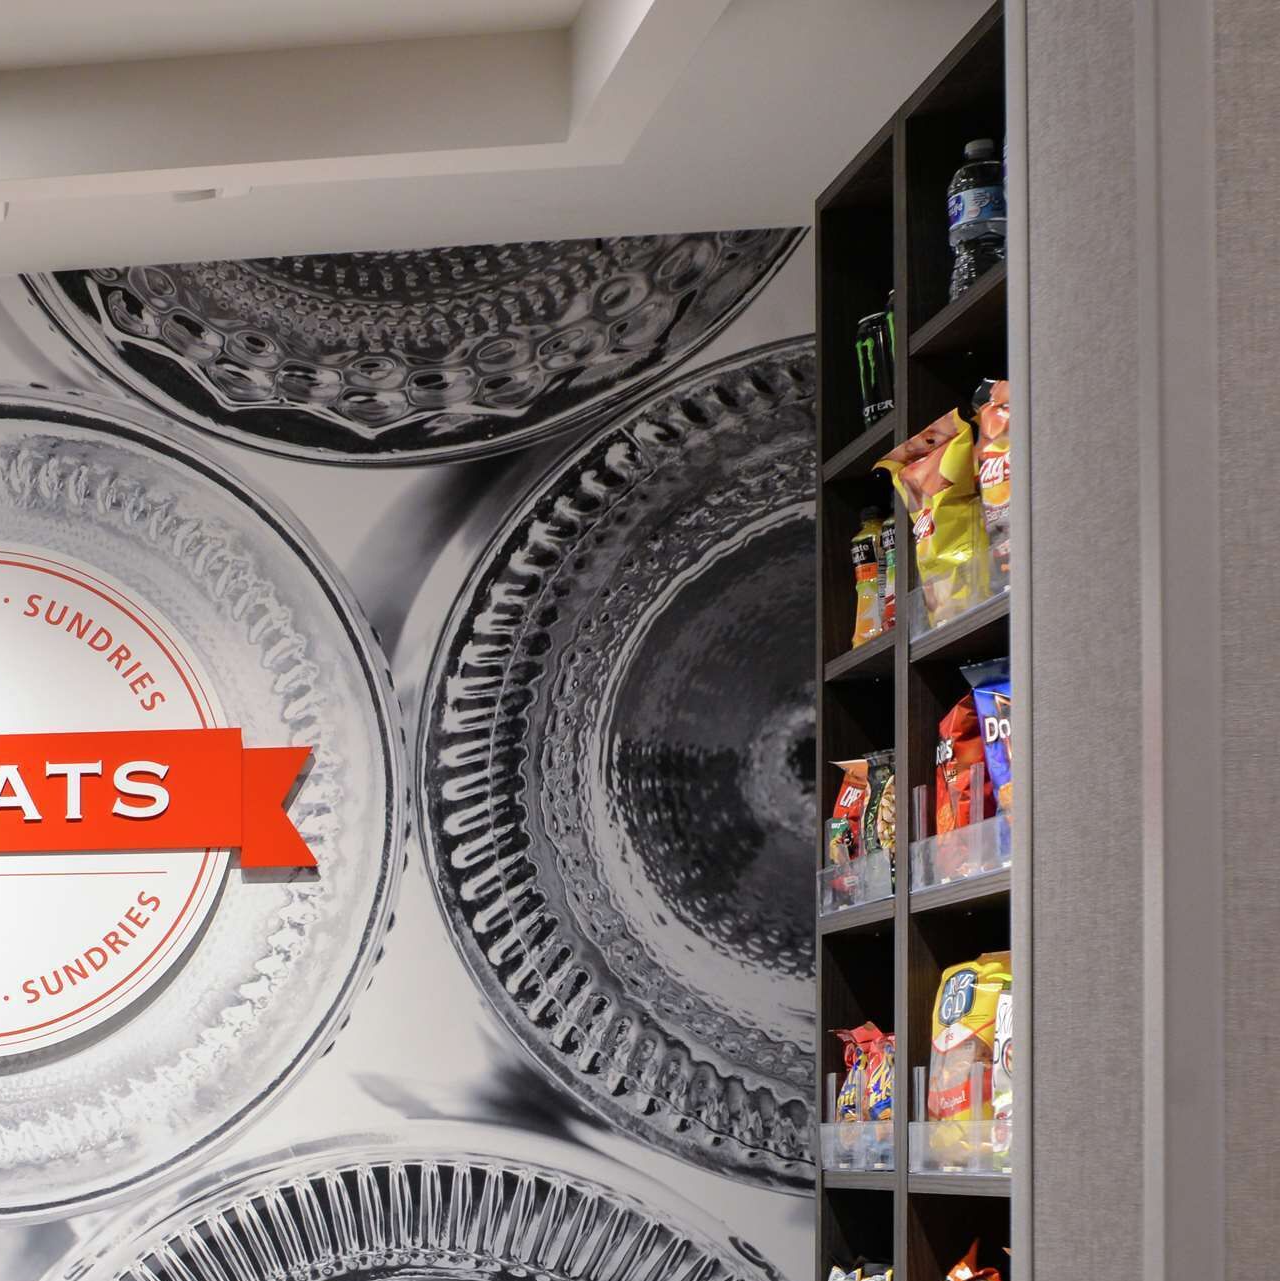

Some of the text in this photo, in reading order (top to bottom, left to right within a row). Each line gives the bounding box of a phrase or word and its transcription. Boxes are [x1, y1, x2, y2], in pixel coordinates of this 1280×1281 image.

[864, 400, 894, 417] STER
[23, 593, 167, 712] SUNDRIES
[21, 890, 161, 1005] SUNDRIES
